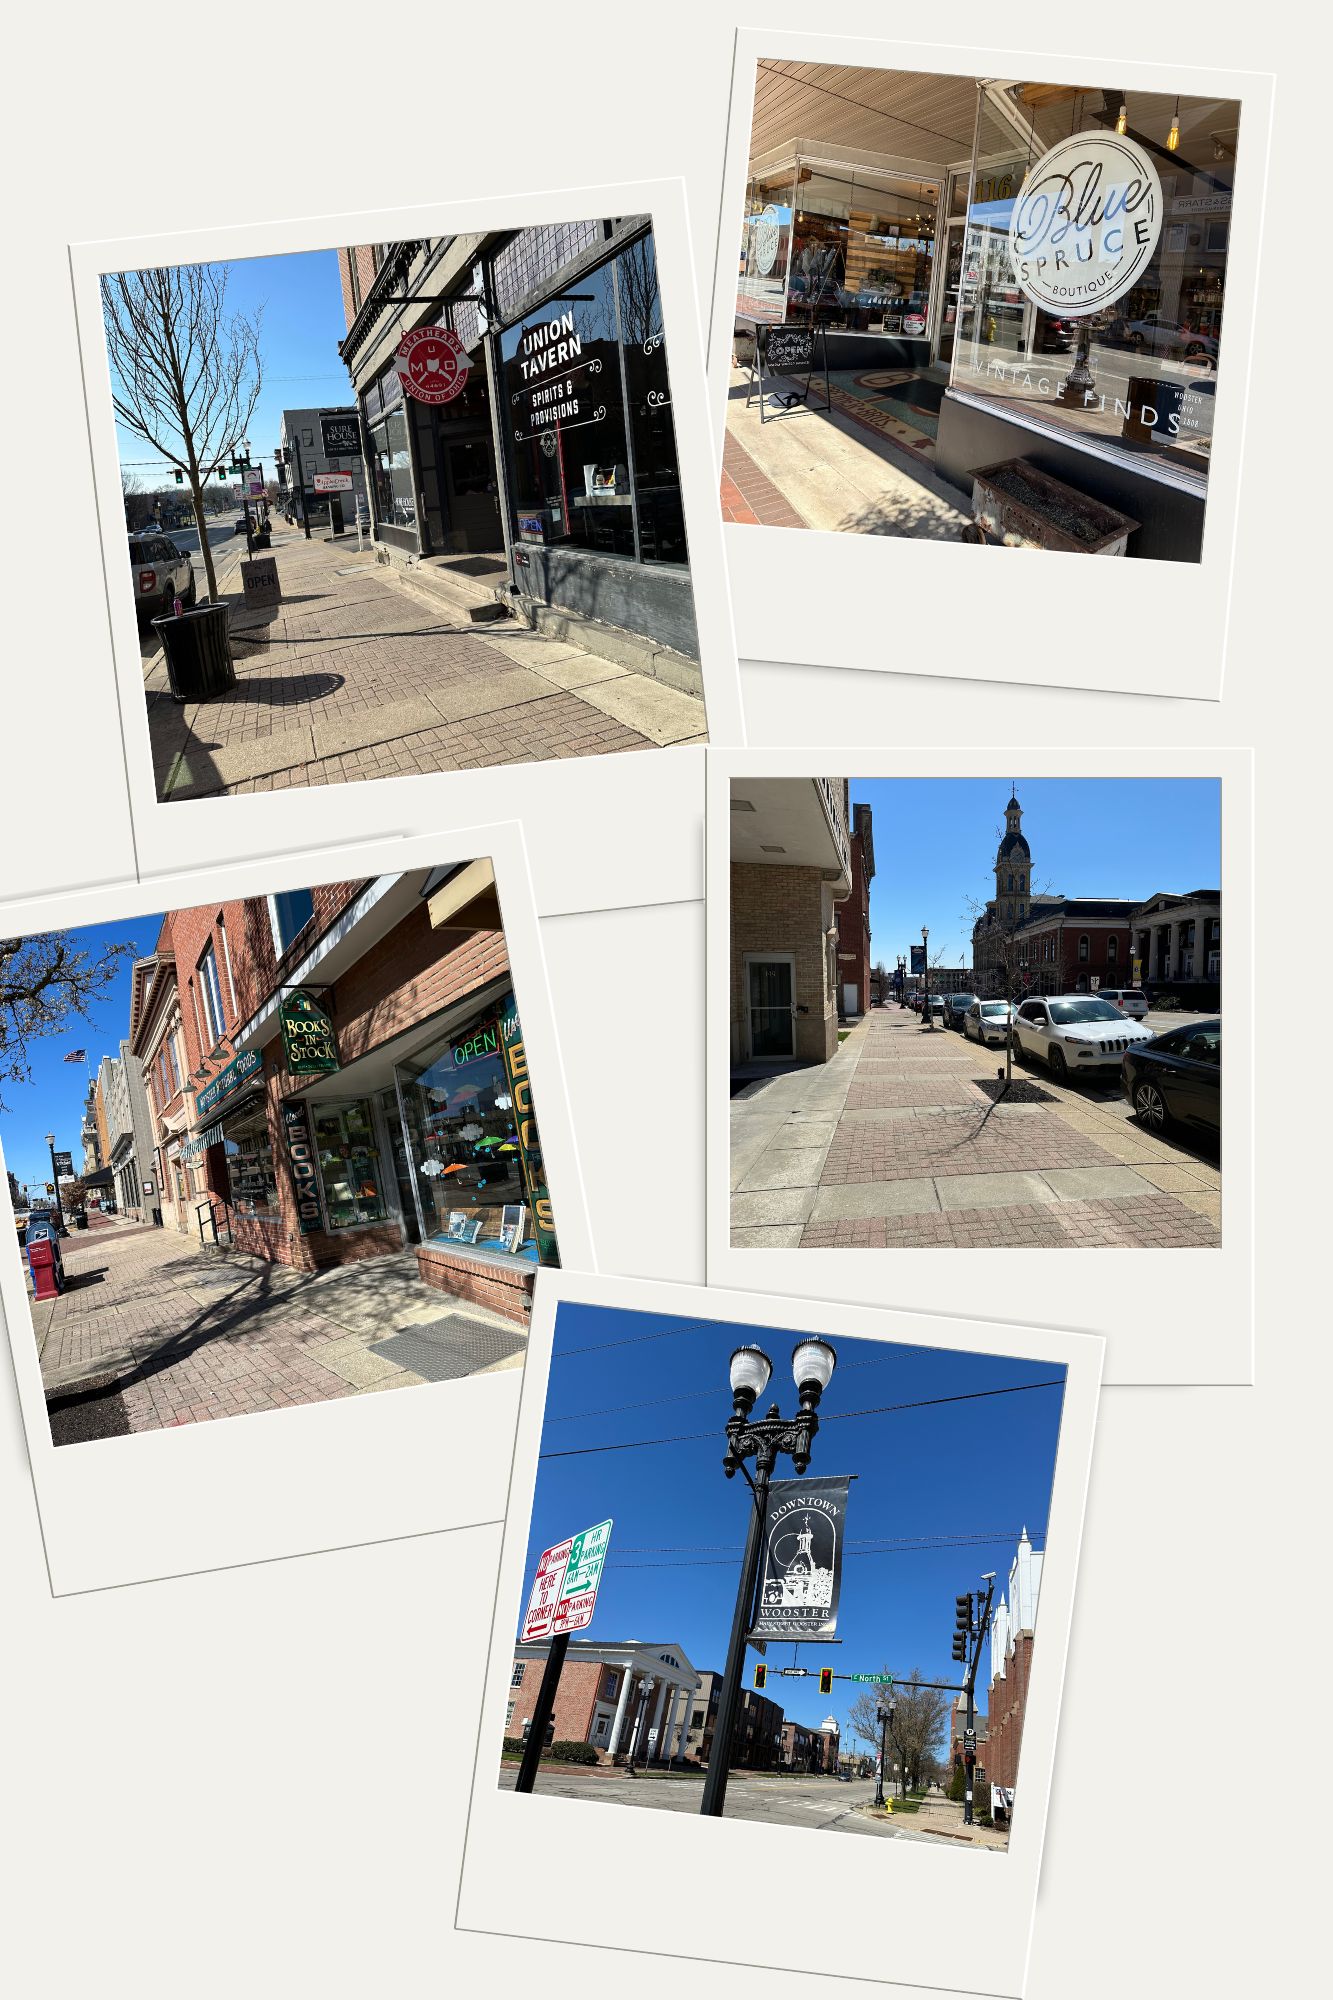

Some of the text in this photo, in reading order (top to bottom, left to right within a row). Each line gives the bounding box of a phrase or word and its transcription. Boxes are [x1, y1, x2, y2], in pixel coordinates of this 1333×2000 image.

[975, 174, 1012, 202] 116
[1014, 161, 1152, 255] Blue
[1020, 219, 1150, 282] SPRUCE
[1053, 271, 1113, 297] BOUTIQUE
[402, 329, 460, 356] MEATHEADS
[522, 311, 574, 355] UNION
[520, 334, 582, 380] TAVERN
[776, 346, 803, 355] OPEN
[411, 362, 424, 373] M
[405, 375, 465, 401] UNION OF OHIO
[532, 380, 573, 407] SPIRITS &
[975, 360, 1181, 434] VINTAGE FINDS
[1174, 391, 1202, 405] WOOSTER
[530, 399, 579, 427] PROVISIONS
[1178, 404, 1193, 414] OHIO
[330, 424, 352, 434] SURE
[1183, 417, 1199, 428] 1808
[326, 431, 357, 441] HOUSE
[520, 518, 543, 532] OPEN
[247, 573, 276, 589] OPEN
[286, 1018, 330, 1038] BOOKS
[304, 1034, 316, 1046] IN
[455, 1026, 497, 1065] OPEN
[290, 1041, 336, 1062] STOCK
[288, 1125, 319, 1220] BOOKS
[770, 1497, 840, 1521] DOWNTOWN
[591, 1529, 602, 1544] HR
[549, 1547, 571, 1566] PARKING
[571, 1540, 606, 1564] 3 PARKING
[539, 1573, 557, 1592] HERE
[539, 1590, 549, 1606] TO
[559, 1596, 593, 1617] NO PARKING
[528, 1603, 554, 1624] CORNER
[761, 1608, 829, 1618] WOOSTER
[860, 1674, 880, 1683] North
